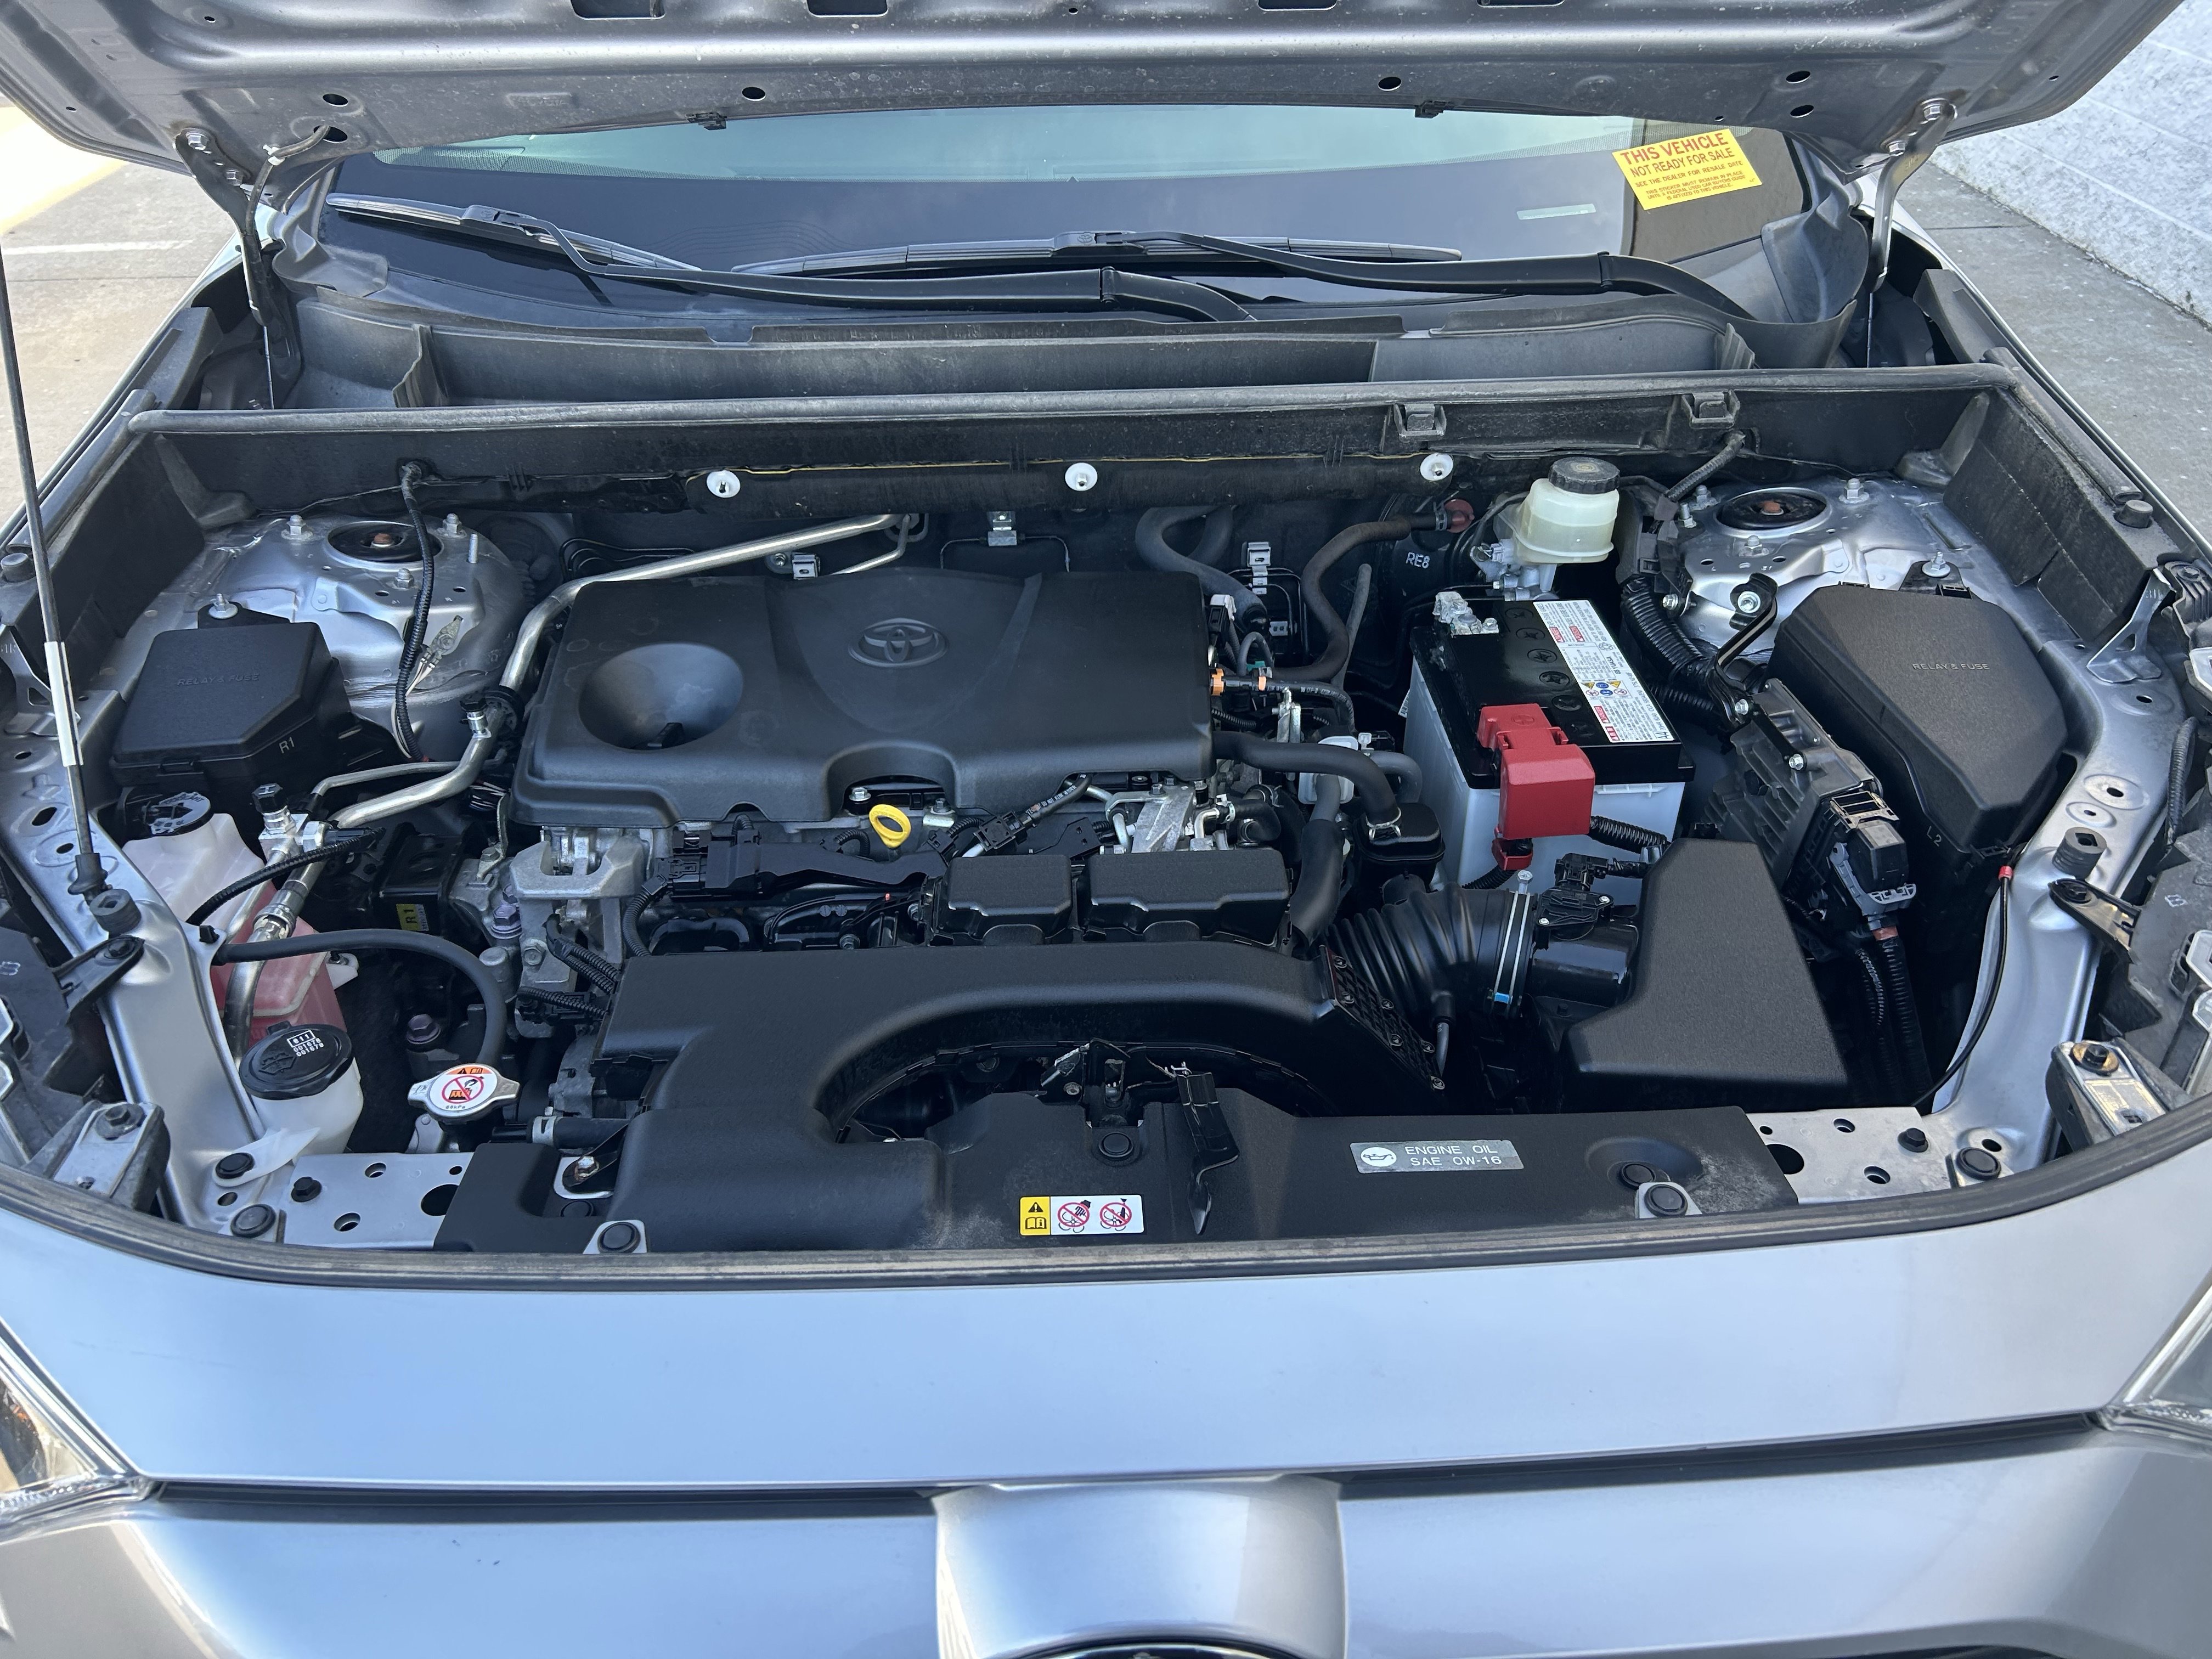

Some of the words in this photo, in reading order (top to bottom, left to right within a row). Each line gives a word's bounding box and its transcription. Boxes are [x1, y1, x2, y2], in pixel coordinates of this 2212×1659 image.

[1620, 147, 1660, 165] THIS
[1659, 133, 1728, 156] VEHICLE
[1630, 165, 1651, 177] NOT
[1652, 157, 1685, 172] READY
[1686, 154, 1709, 165] FOR
[1708, 148, 1735, 160] SALE
[1662, 173, 1686, 181] DEALER
[1702, 164, 1725, 173] RESALE
[1406, 552, 1430, 569] RE8
[177, 676, 216, 685] RELAY
[229, 673, 259, 681] FUSE
[279, 737, 295, 753] R1
[258, 785, 276, 795] H
[1927, 826, 1942, 847] L2
[403, 909, 418, 924] R1
[293, 1038, 321, 1052] 001678
[296, 1042, 324, 1057] 001679
[1404, 1146, 1463, 1155] ENGINE
[1472, 1145, 1498, 1154] OIL
[1410, 1158, 1442, 1166] SAE
[1452, 1156, 1502, 1166] 0W-16
